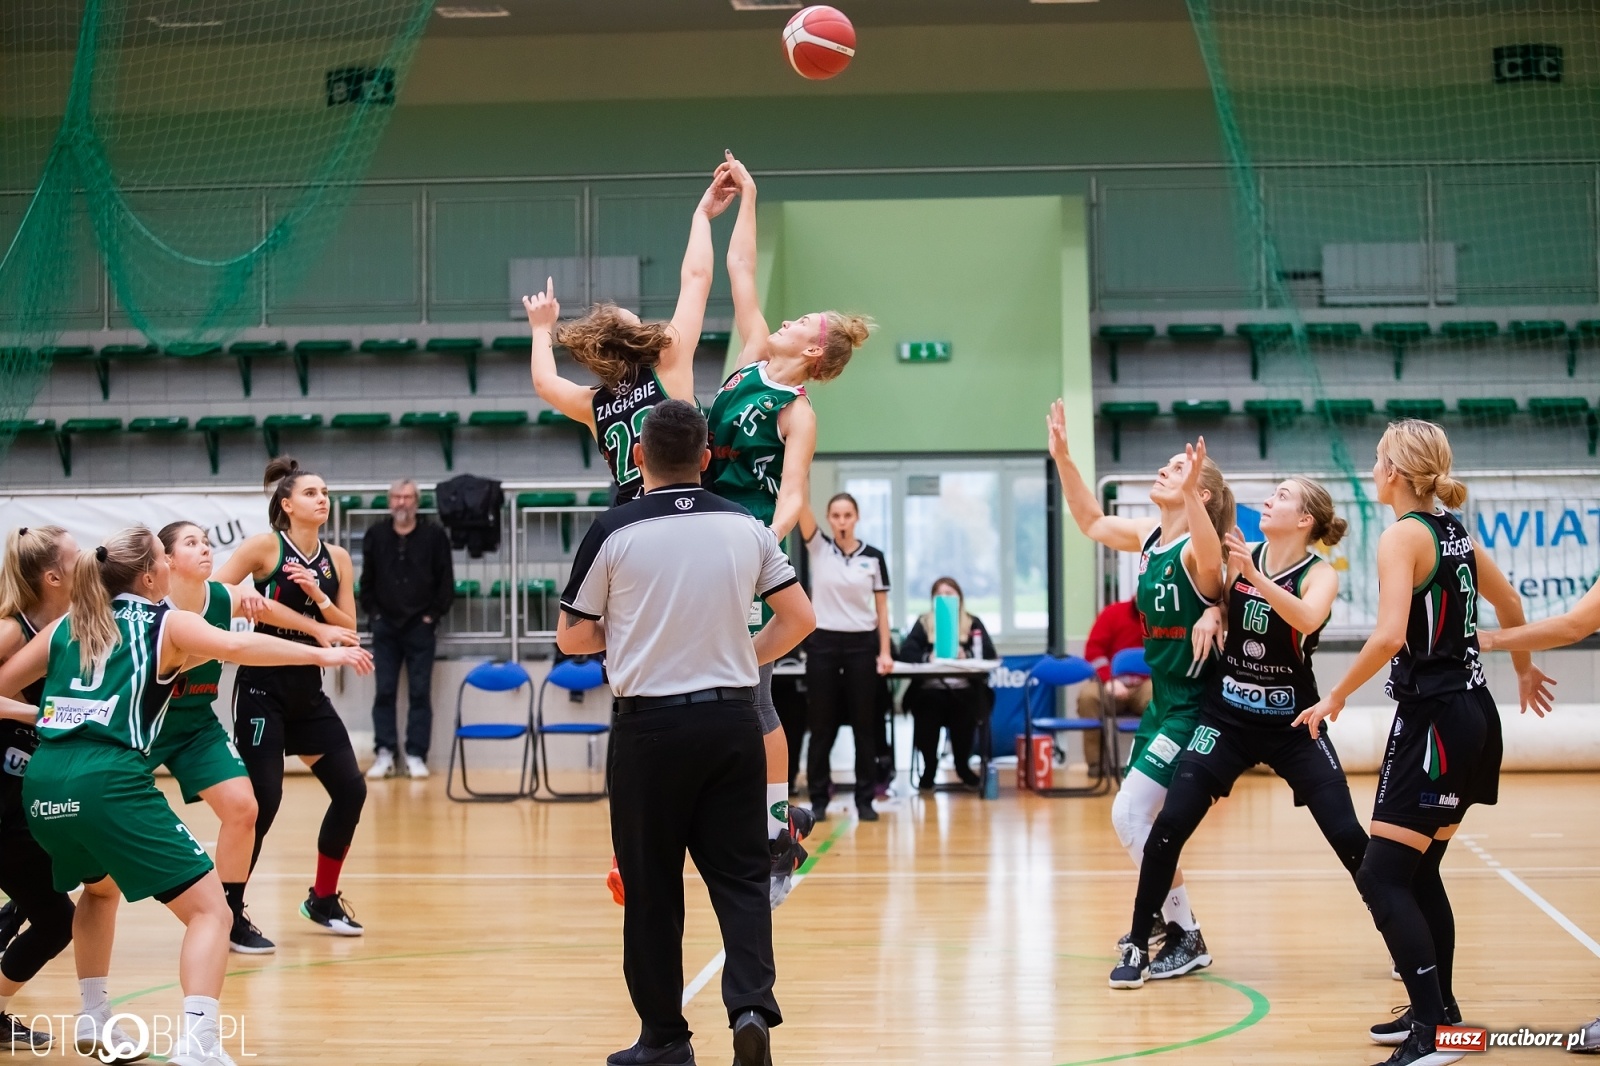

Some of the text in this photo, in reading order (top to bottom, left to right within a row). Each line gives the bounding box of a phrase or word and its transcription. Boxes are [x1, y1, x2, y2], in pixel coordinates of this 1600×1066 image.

[604, 405, 656, 486] 2
[1154, 583, 1181, 612] 27
[1243, 599, 1272, 635] 15
[1242, 659, 1294, 674] LOGISTICS
[250, 717, 266, 746] 7
[1186, 724, 1221, 755] 15
[1036, 741, 1050, 778] 5
[1388, 740, 1396, 757] CTL
[1377, 759, 1393, 804] LOGISTICS
[39, 798, 81, 816] Clavis
[175, 823, 205, 856] 3
